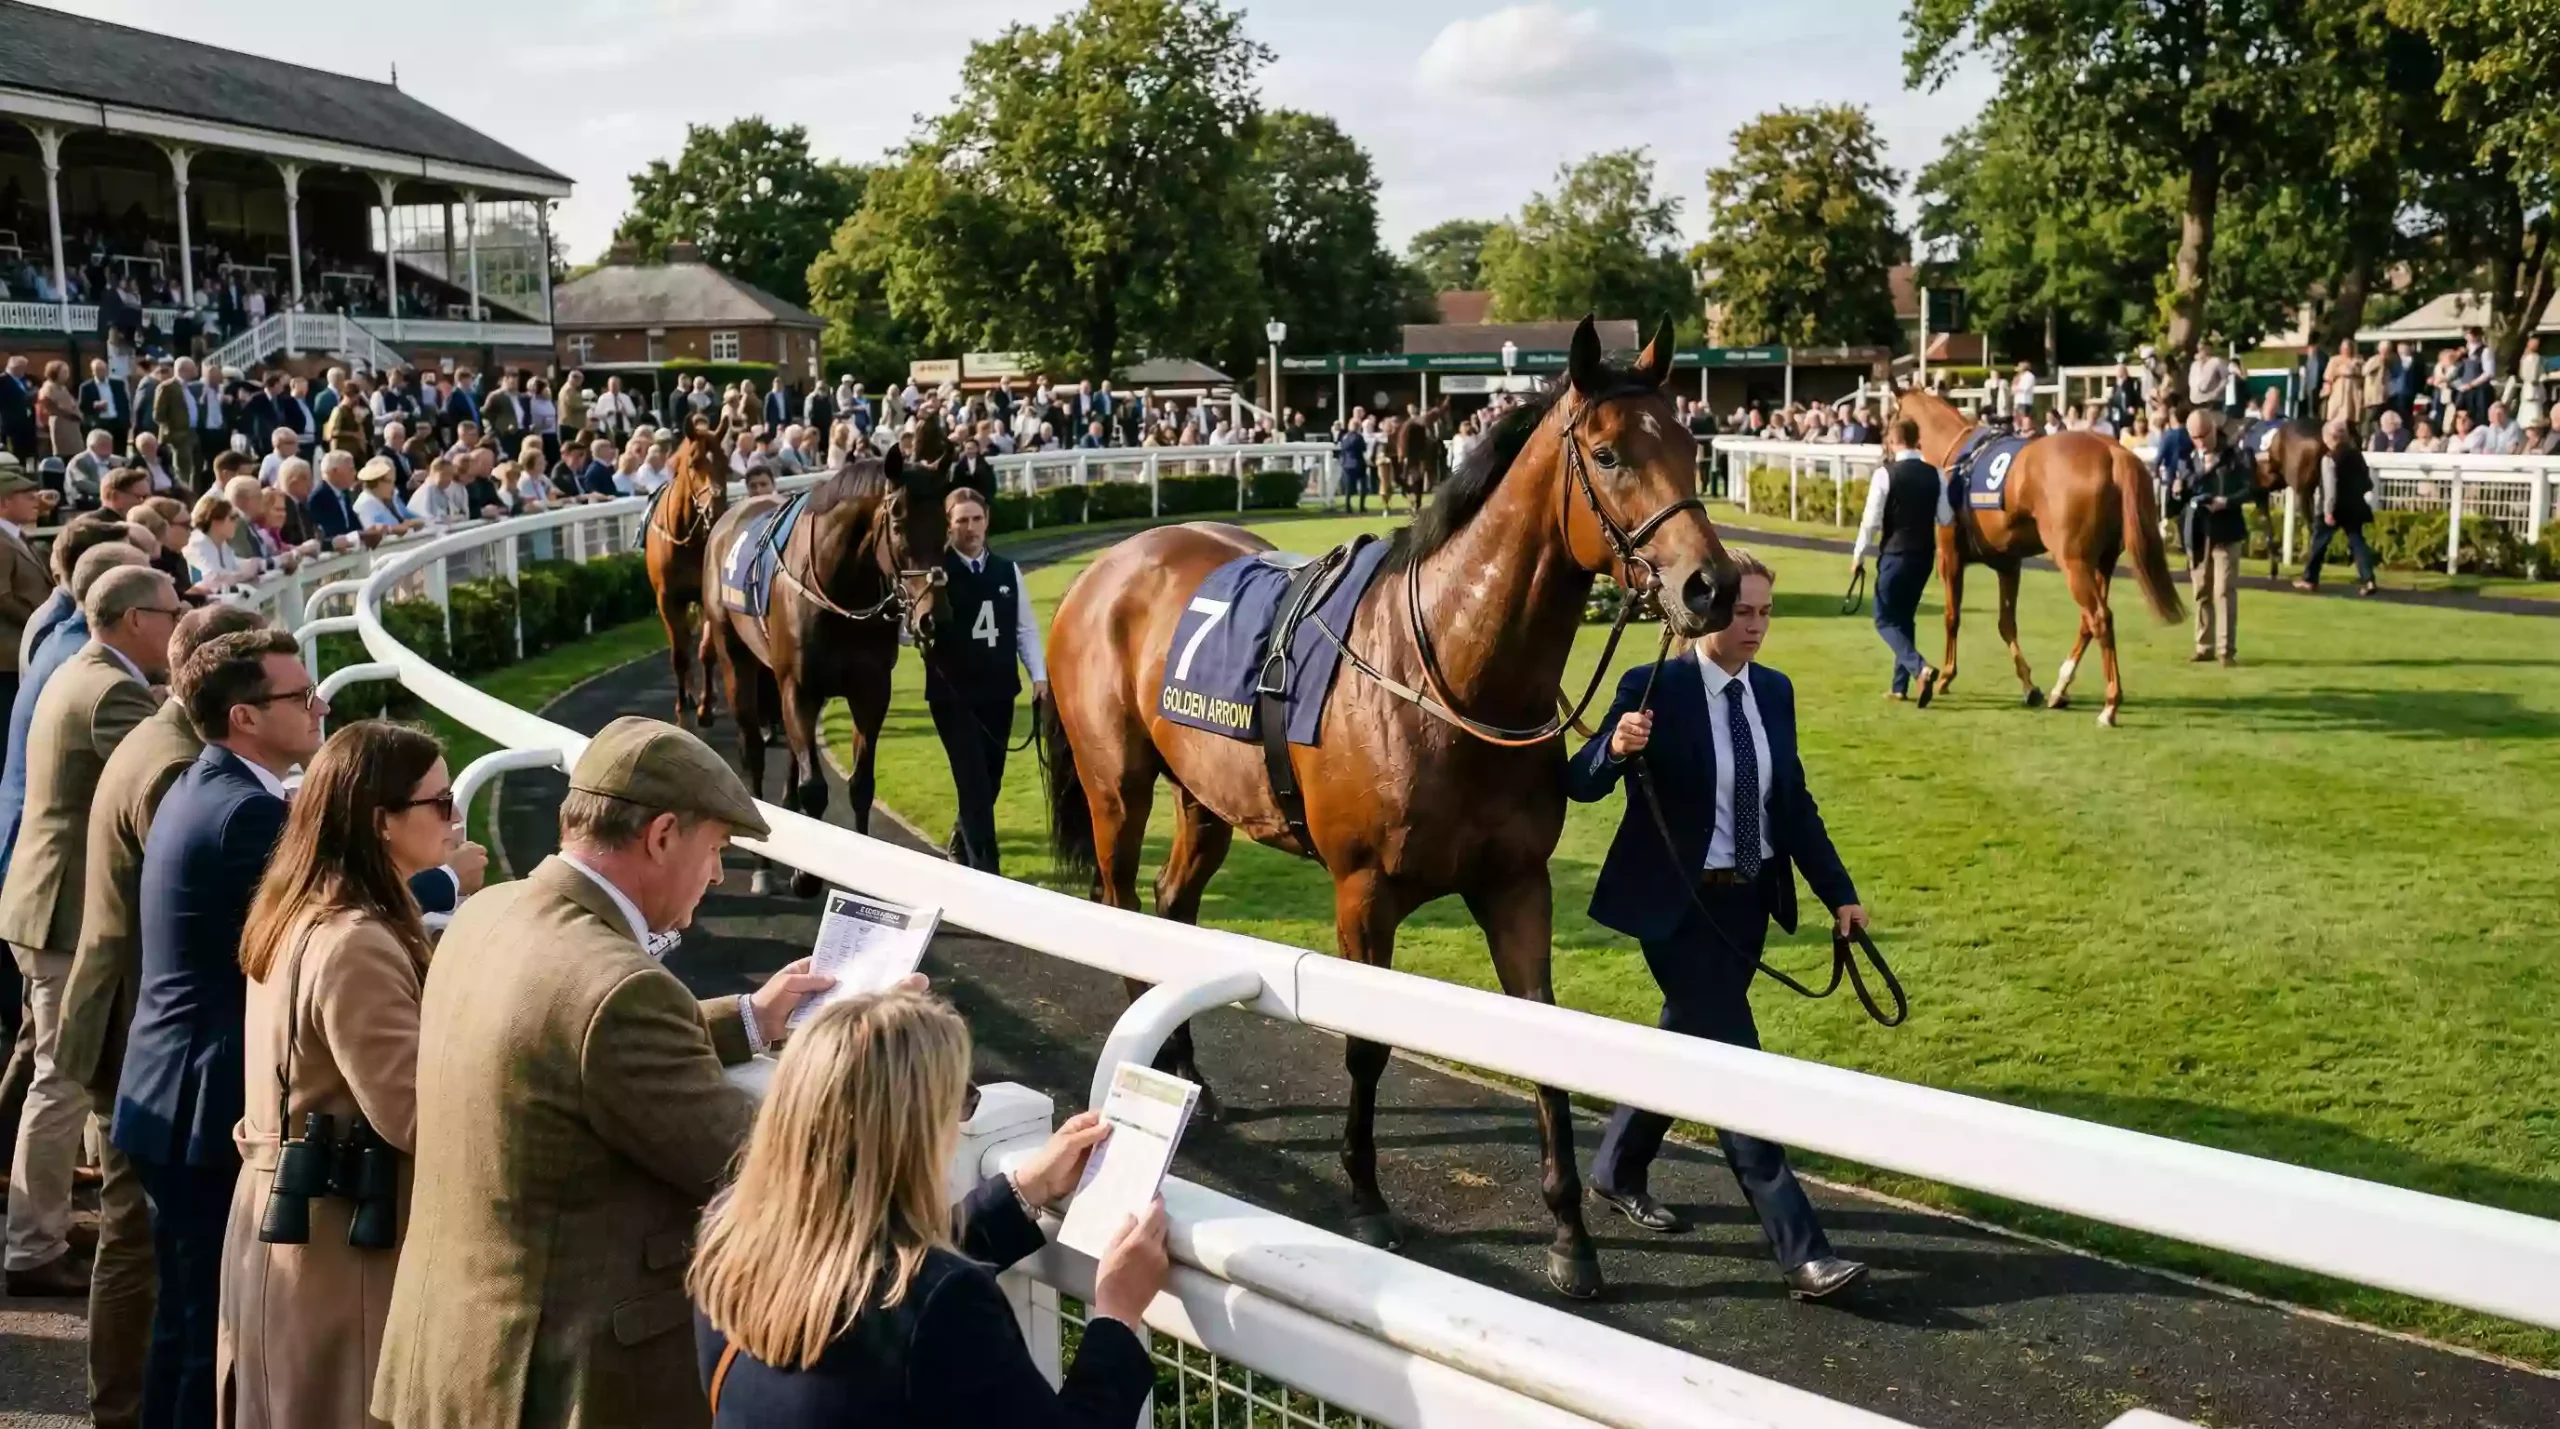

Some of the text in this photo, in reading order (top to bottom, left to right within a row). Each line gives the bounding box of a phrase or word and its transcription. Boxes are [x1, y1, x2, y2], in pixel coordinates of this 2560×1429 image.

[1986, 452, 2011, 490] 9
[725, 531, 749, 580] 4
[972, 600, 999, 648] 4
[1175, 596, 1231, 681] 7
[1163, 686, 1253, 730] GOLDEN ARROW
[835, 899, 846, 913] 7
